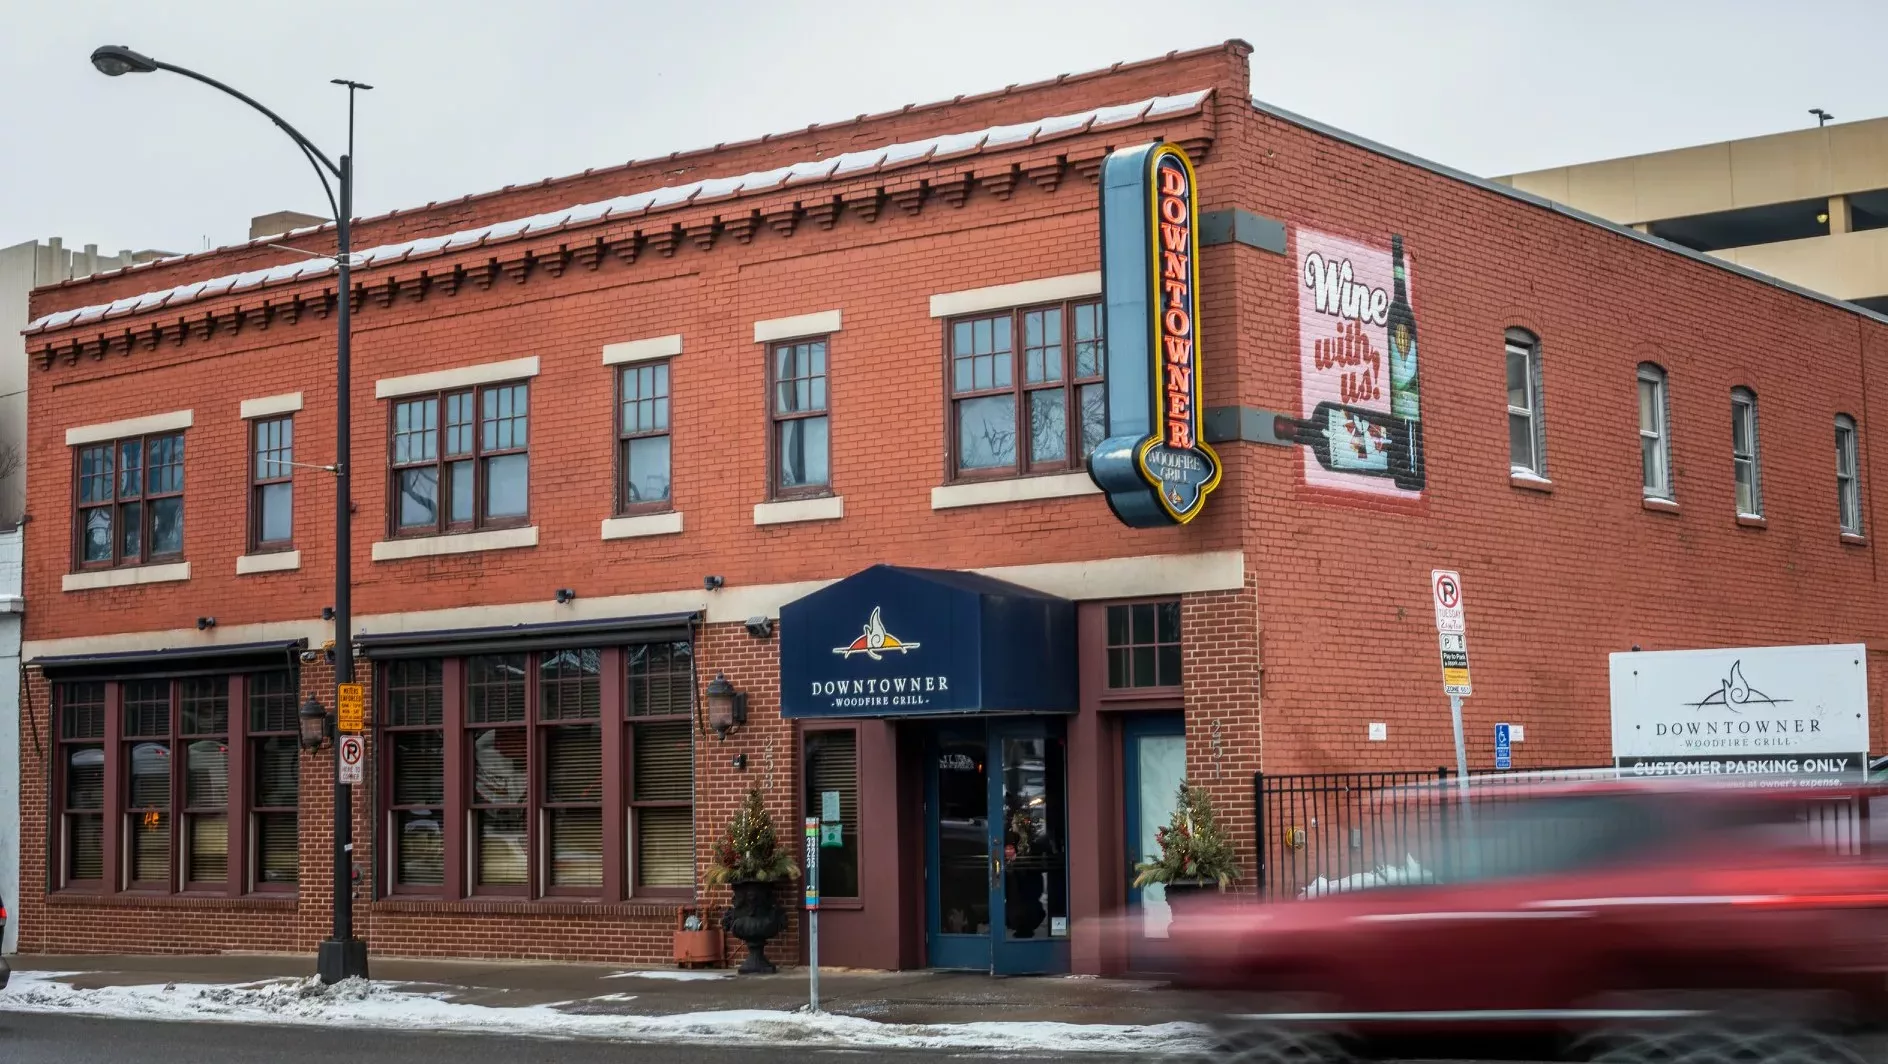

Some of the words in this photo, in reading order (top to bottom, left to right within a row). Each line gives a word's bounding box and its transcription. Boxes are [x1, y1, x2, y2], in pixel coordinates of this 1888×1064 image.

[1304, 251, 1390, 327] Wine
[1162, 166, 1193, 450] DOWNTOWNER
[1314, 321, 1378, 370] with
[1340, 352, 1381, 404] us!
[1148, 451, 1200, 470] WOODFIRE
[1160, 467, 1191, 483] GRILL
[812, 676, 949, 696] DOWNTOWNER
[1655, 718, 1823, 737] DOWNTOWNER
[764, 735, 774, 790] 253
[1211, 718, 1223, 780] 251
[1633, 760, 1721, 776] CUSTOMER
[1725, 760, 1799, 774] PARKING
[1803, 758, 1849, 773] ONLY
[1760, 777, 1800, 788] owner's
[1801, 775, 1843, 788] expense.
